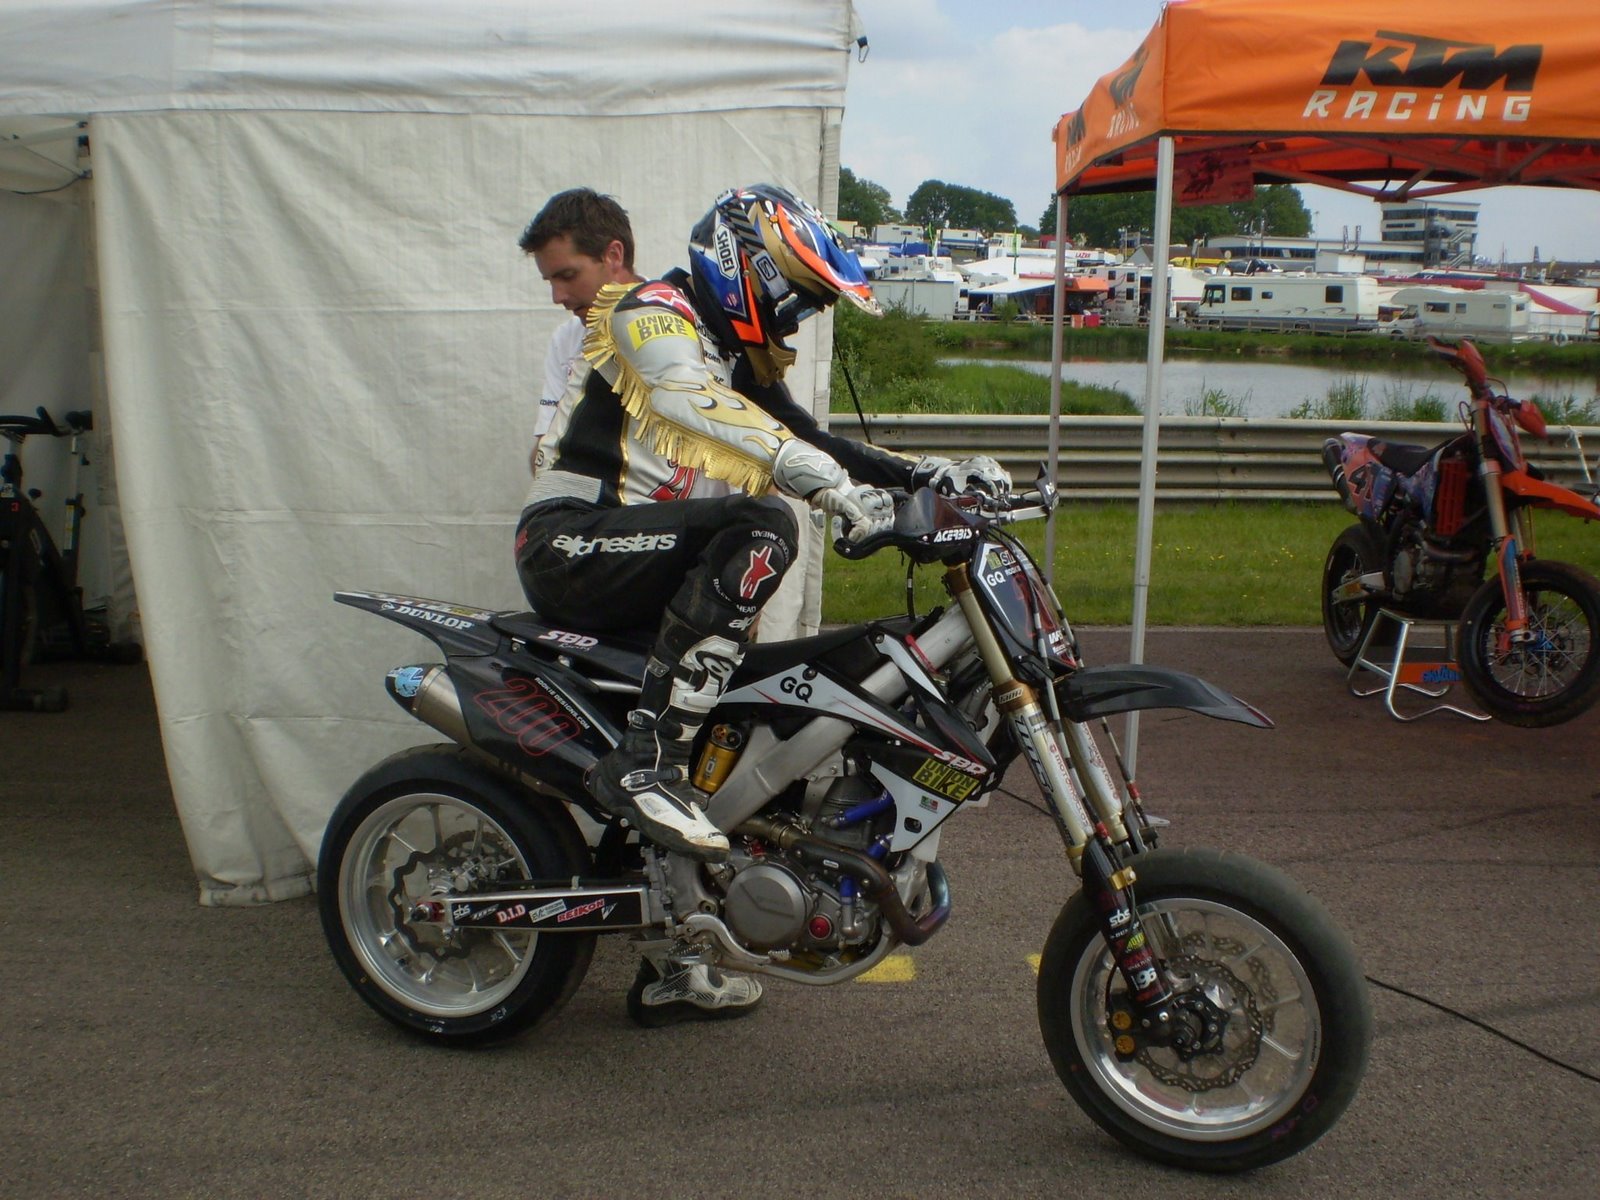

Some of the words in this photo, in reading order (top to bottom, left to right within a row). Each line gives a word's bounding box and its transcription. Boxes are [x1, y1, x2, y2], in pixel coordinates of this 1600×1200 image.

[1320, 29, 1544, 92] KTM
[715, 230, 735, 273] SHOEI
[635, 315, 686, 329] UNION
[638, 322, 688, 342] BIKE
[933, 528, 973, 543] ACERBIS
[986, 571, 1006, 587] GQ
[394, 605, 474, 630] DUNLOP
[538, 630, 599, 647] SBD
[780, 676, 813, 703] GQ
[924, 759, 977, 788] UNION
[934, 750, 987, 775] SBD
[914, 767, 967, 798] BIKE
[453, 903, 471, 920] sbs
